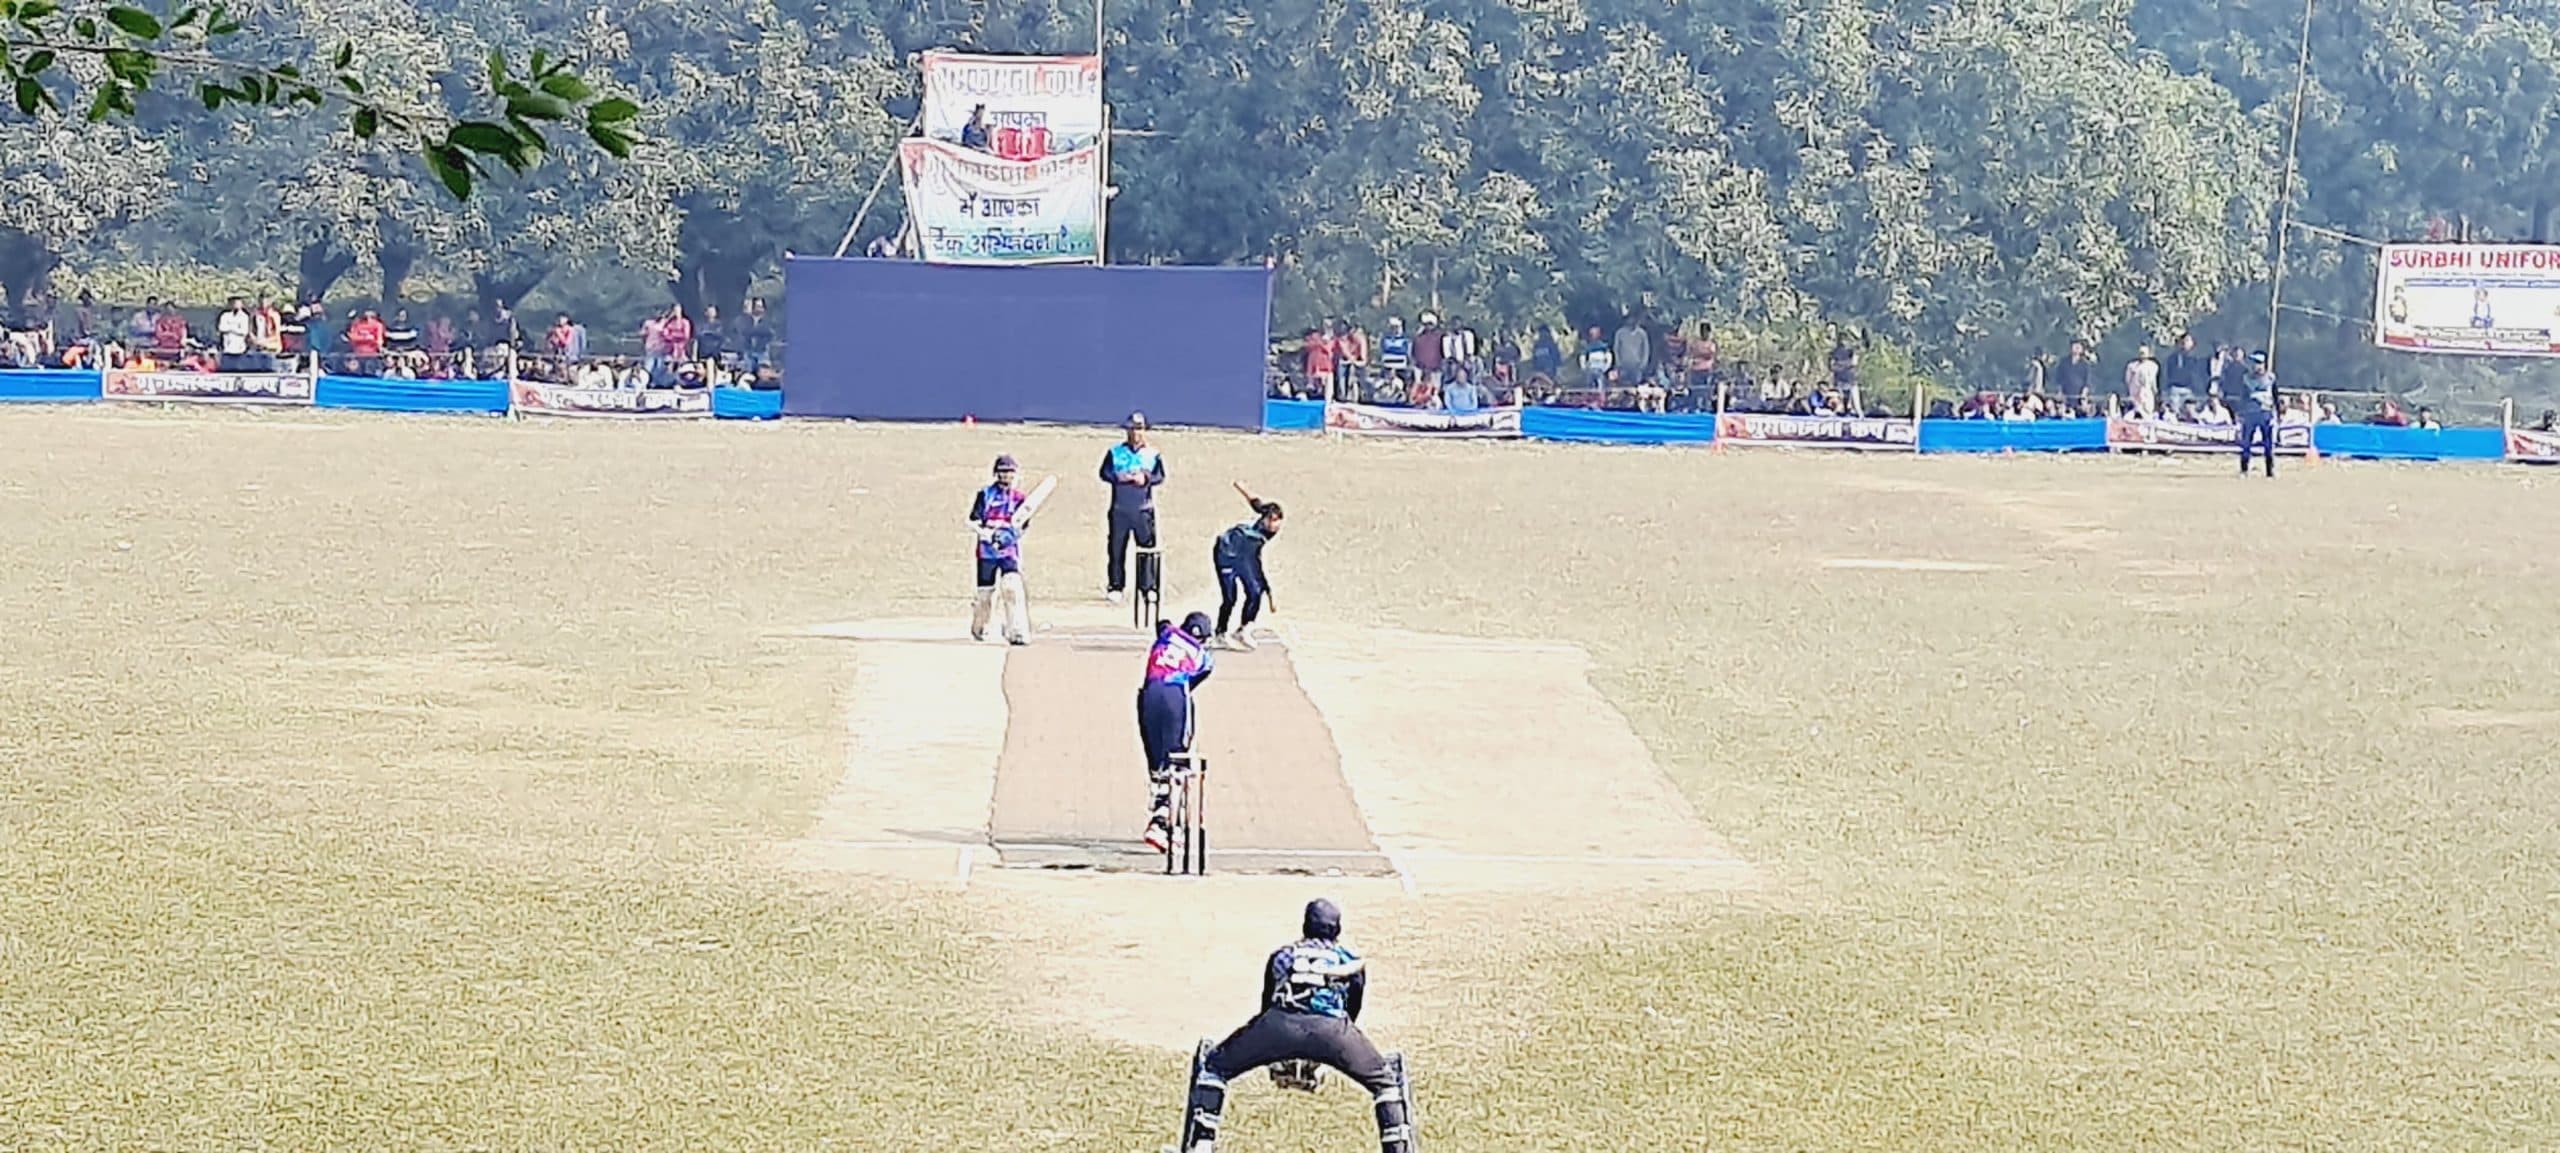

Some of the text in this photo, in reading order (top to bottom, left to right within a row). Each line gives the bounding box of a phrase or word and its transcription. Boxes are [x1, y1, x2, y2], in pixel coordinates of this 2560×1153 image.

[959, 192, 1040, 218] में आपका
[2390, 250, 2472, 268] SURBHI
